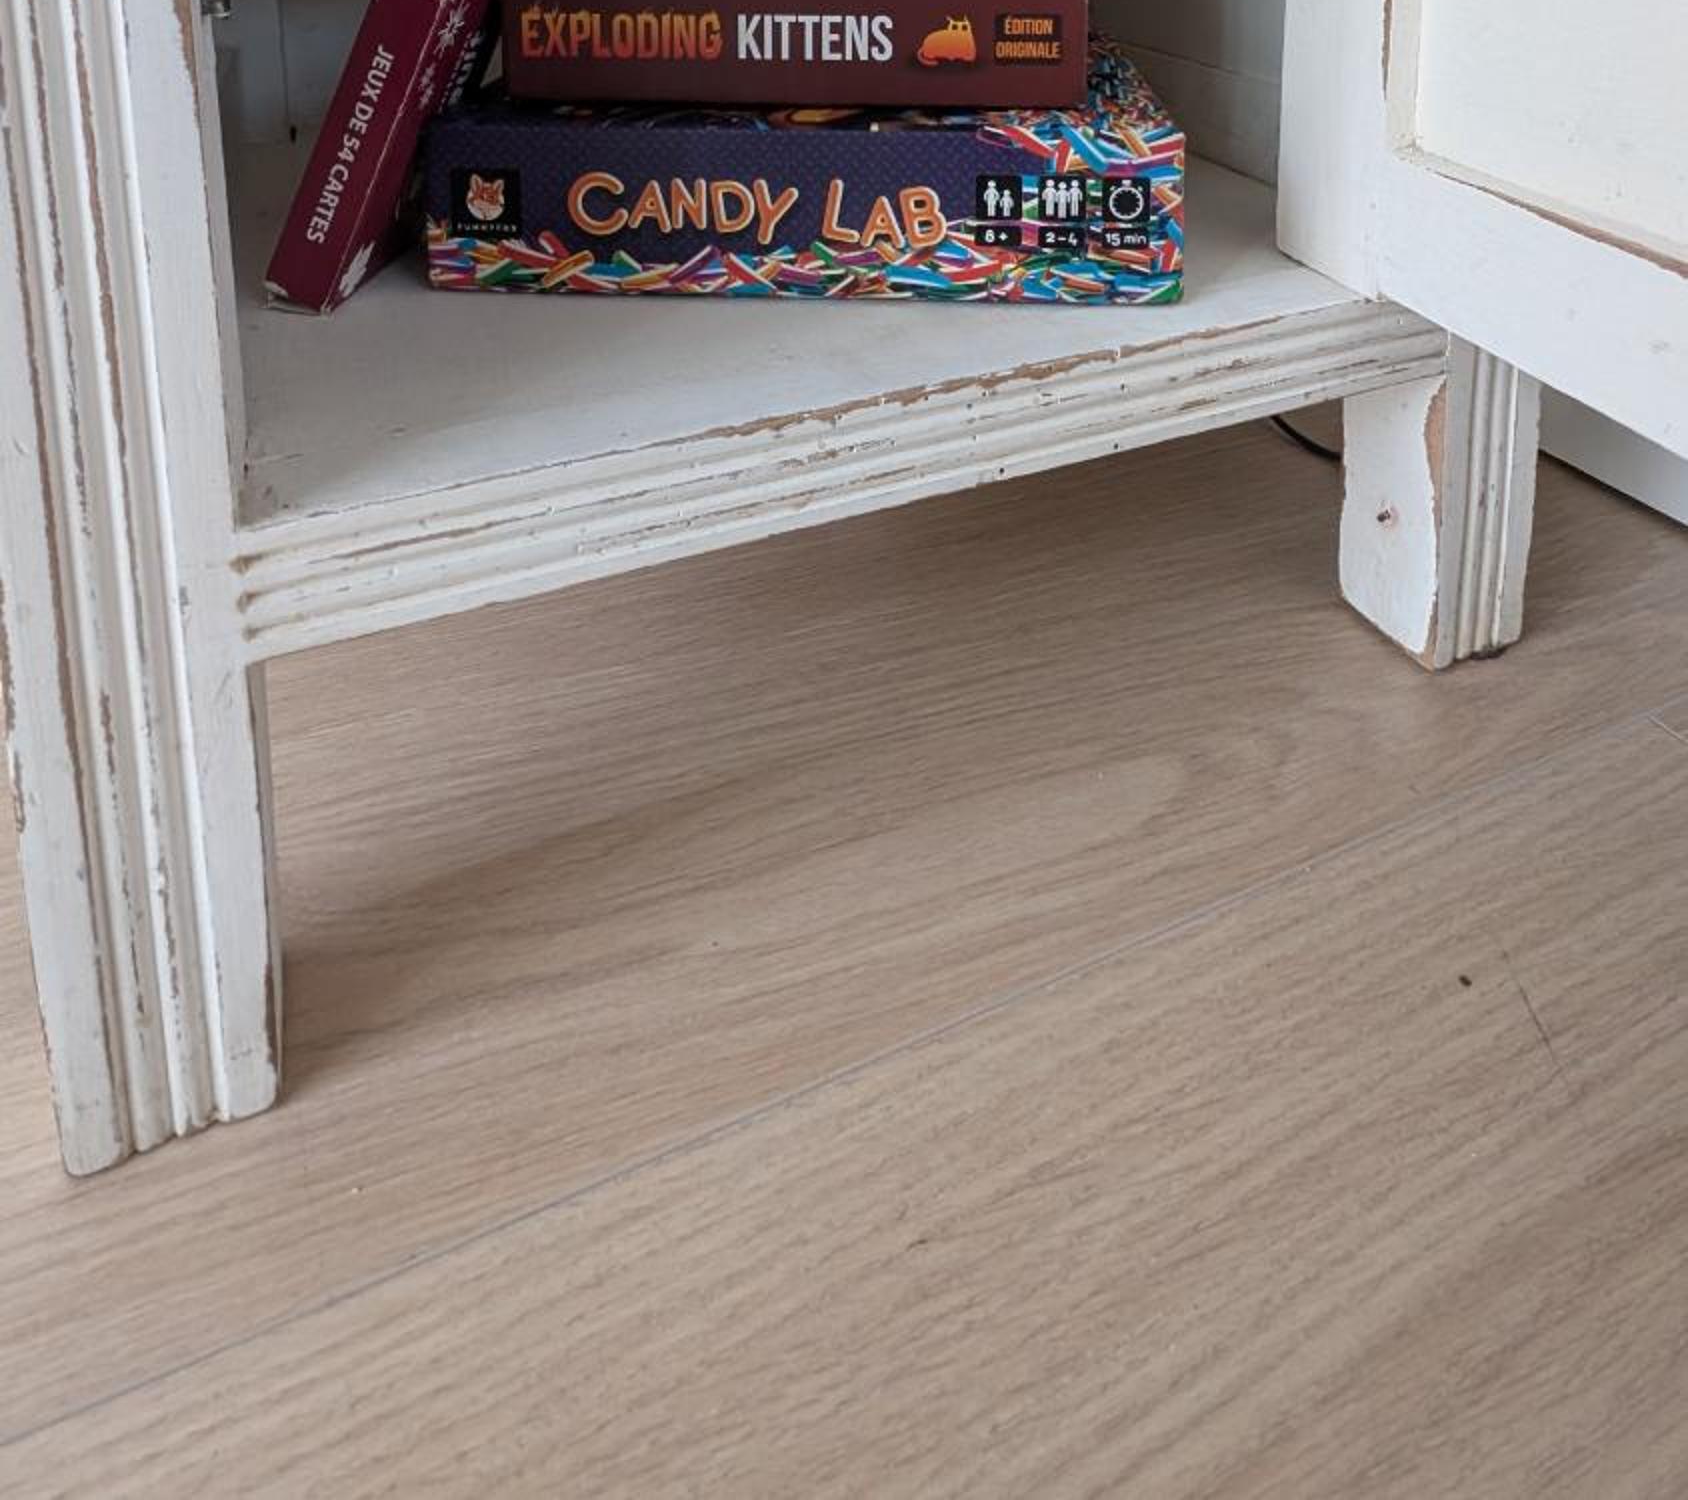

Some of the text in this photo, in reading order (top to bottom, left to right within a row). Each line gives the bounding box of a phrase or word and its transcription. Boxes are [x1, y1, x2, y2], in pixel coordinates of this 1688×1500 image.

[520, 3, 894, 62] EXPLODING KITTENS
[1005, 14, 1053, 35] ÉDITION
[995, 41, 1061, 58] ORIGINALE
[306, 44, 395, 244] JEUX DE 54 CARTES
[567, 171, 947, 248] CANDY LAB
[1105, 232, 1147, 247] 15 min
